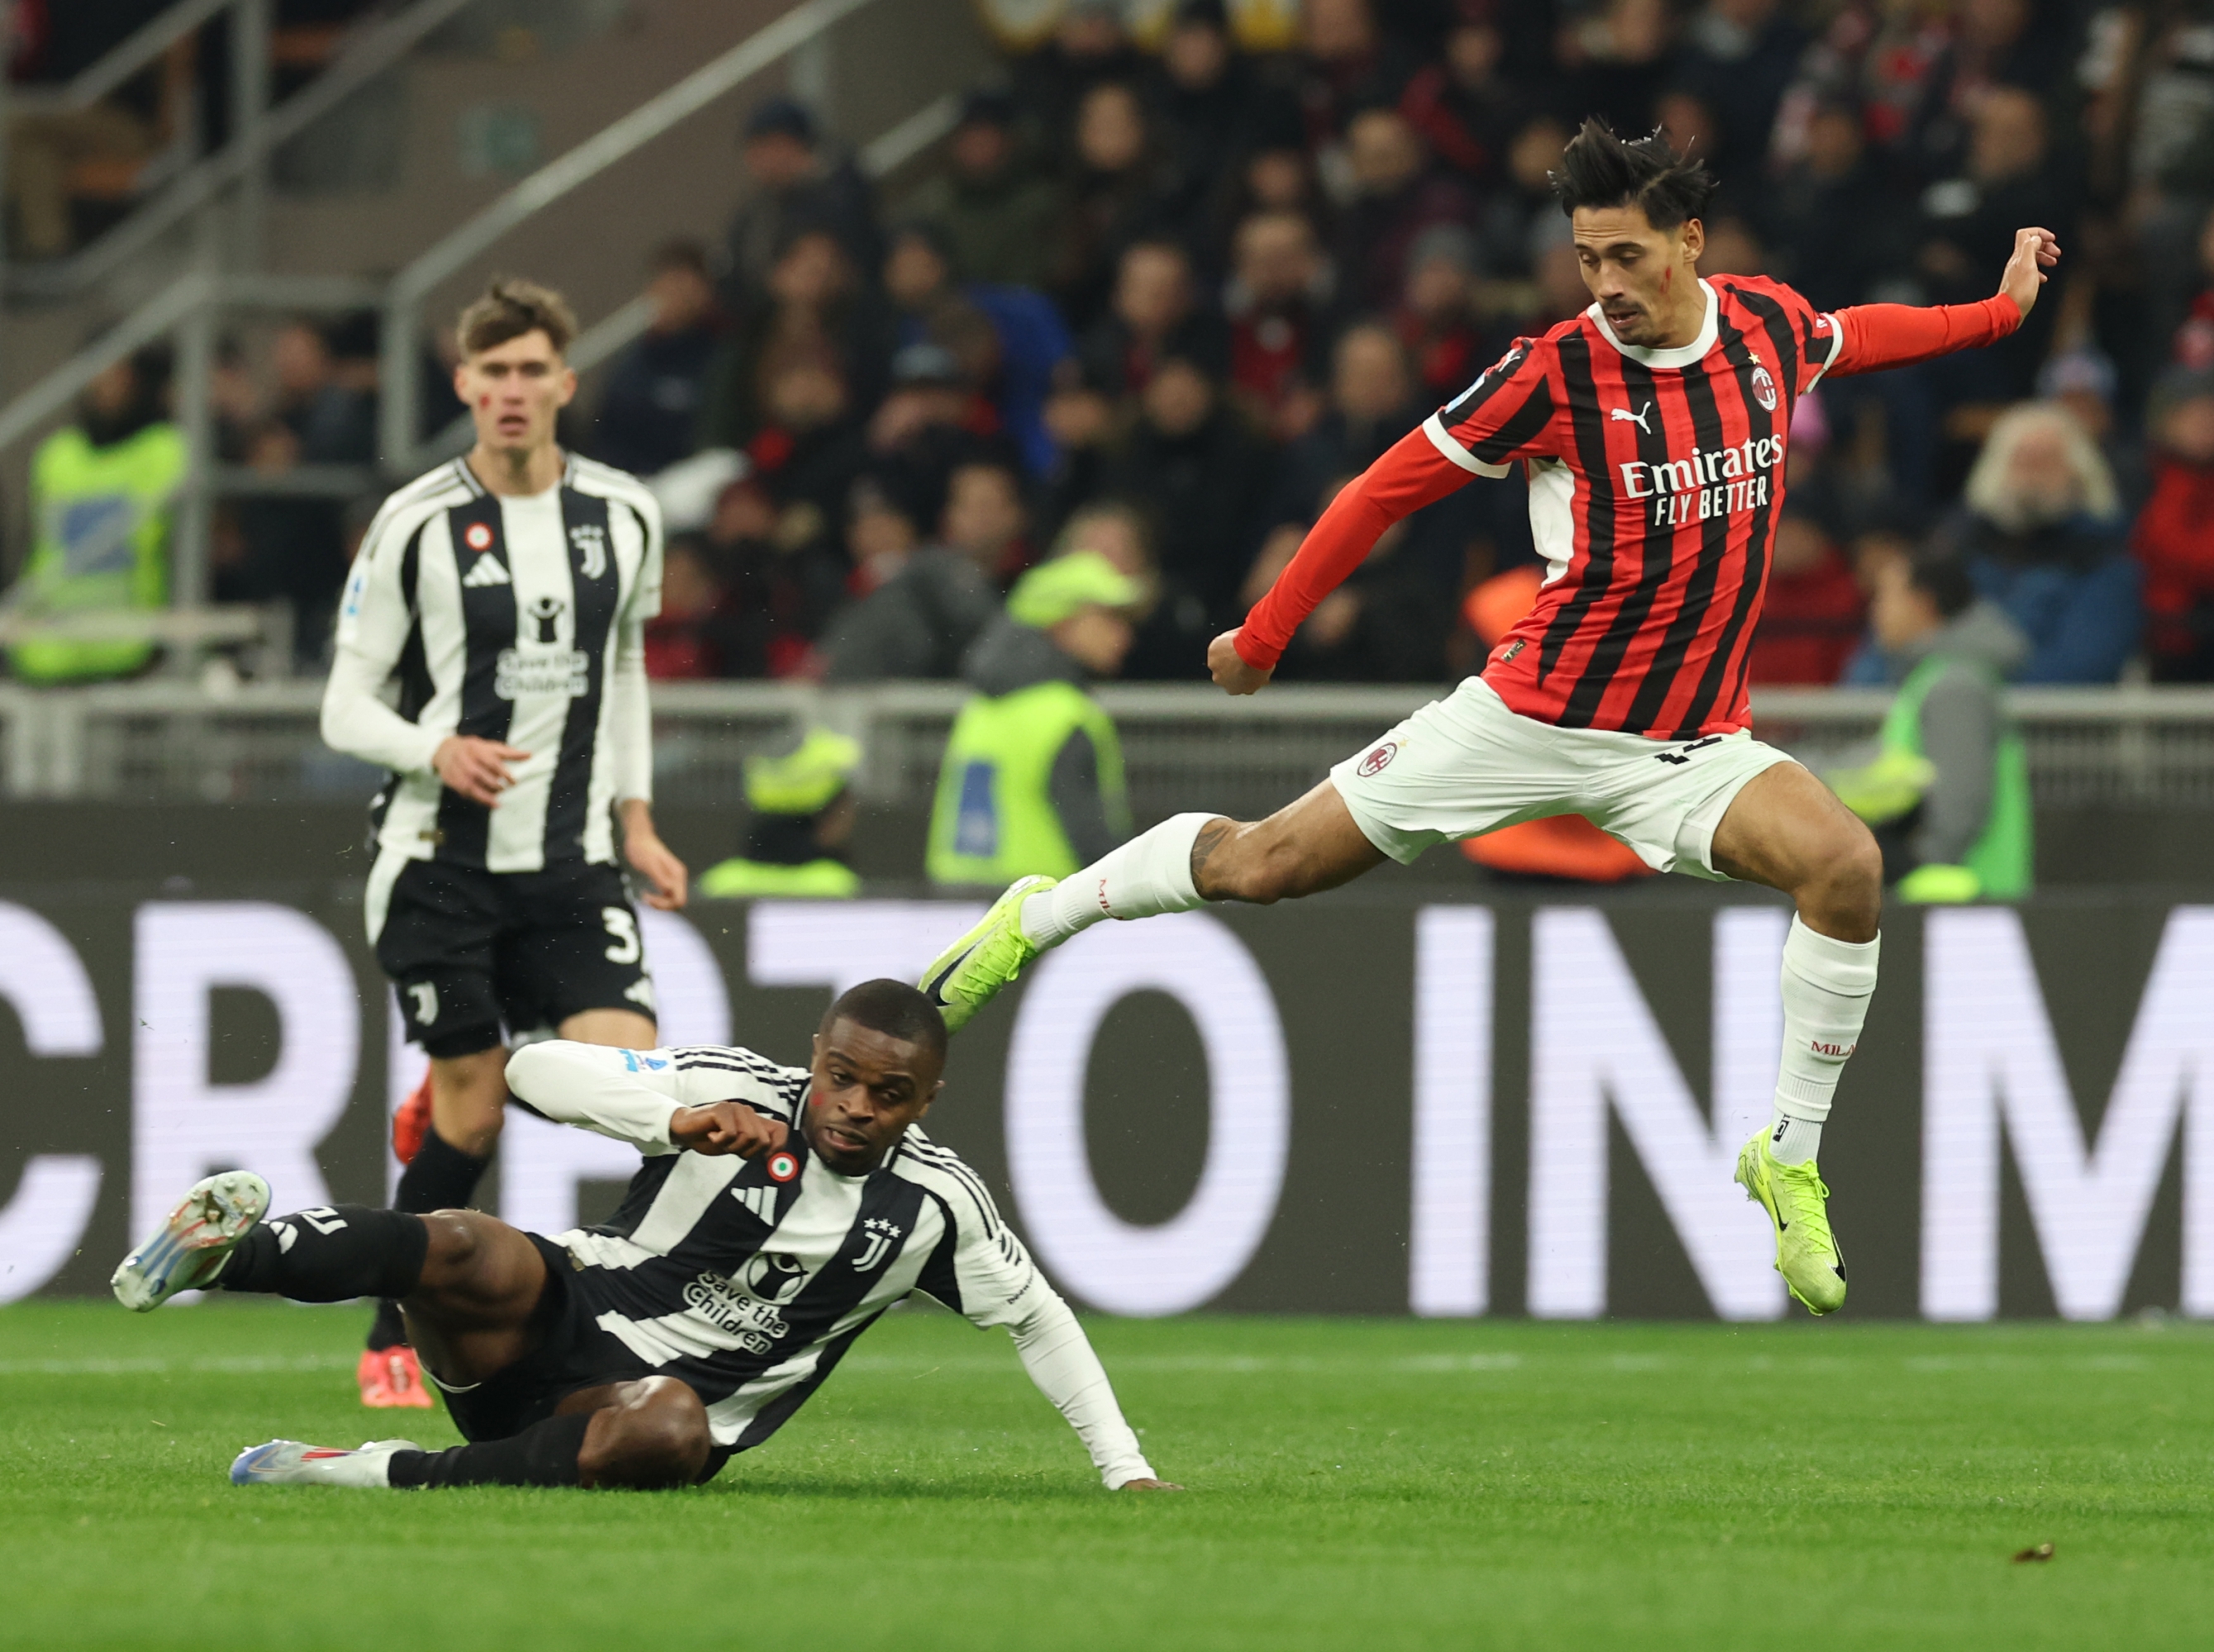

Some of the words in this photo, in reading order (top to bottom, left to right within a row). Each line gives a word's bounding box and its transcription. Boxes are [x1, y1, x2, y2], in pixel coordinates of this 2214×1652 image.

[1618, 434, 1784, 499] Emirates
[1654, 493, 1693, 526] FLY
[1698, 475, 1768, 520] BETTER
[1410, 905, 1790, 1321] IN
[687, 1283, 770, 1354] Children
[701, 1270, 751, 1312] Save
[752, 1304, 786, 1336] the
